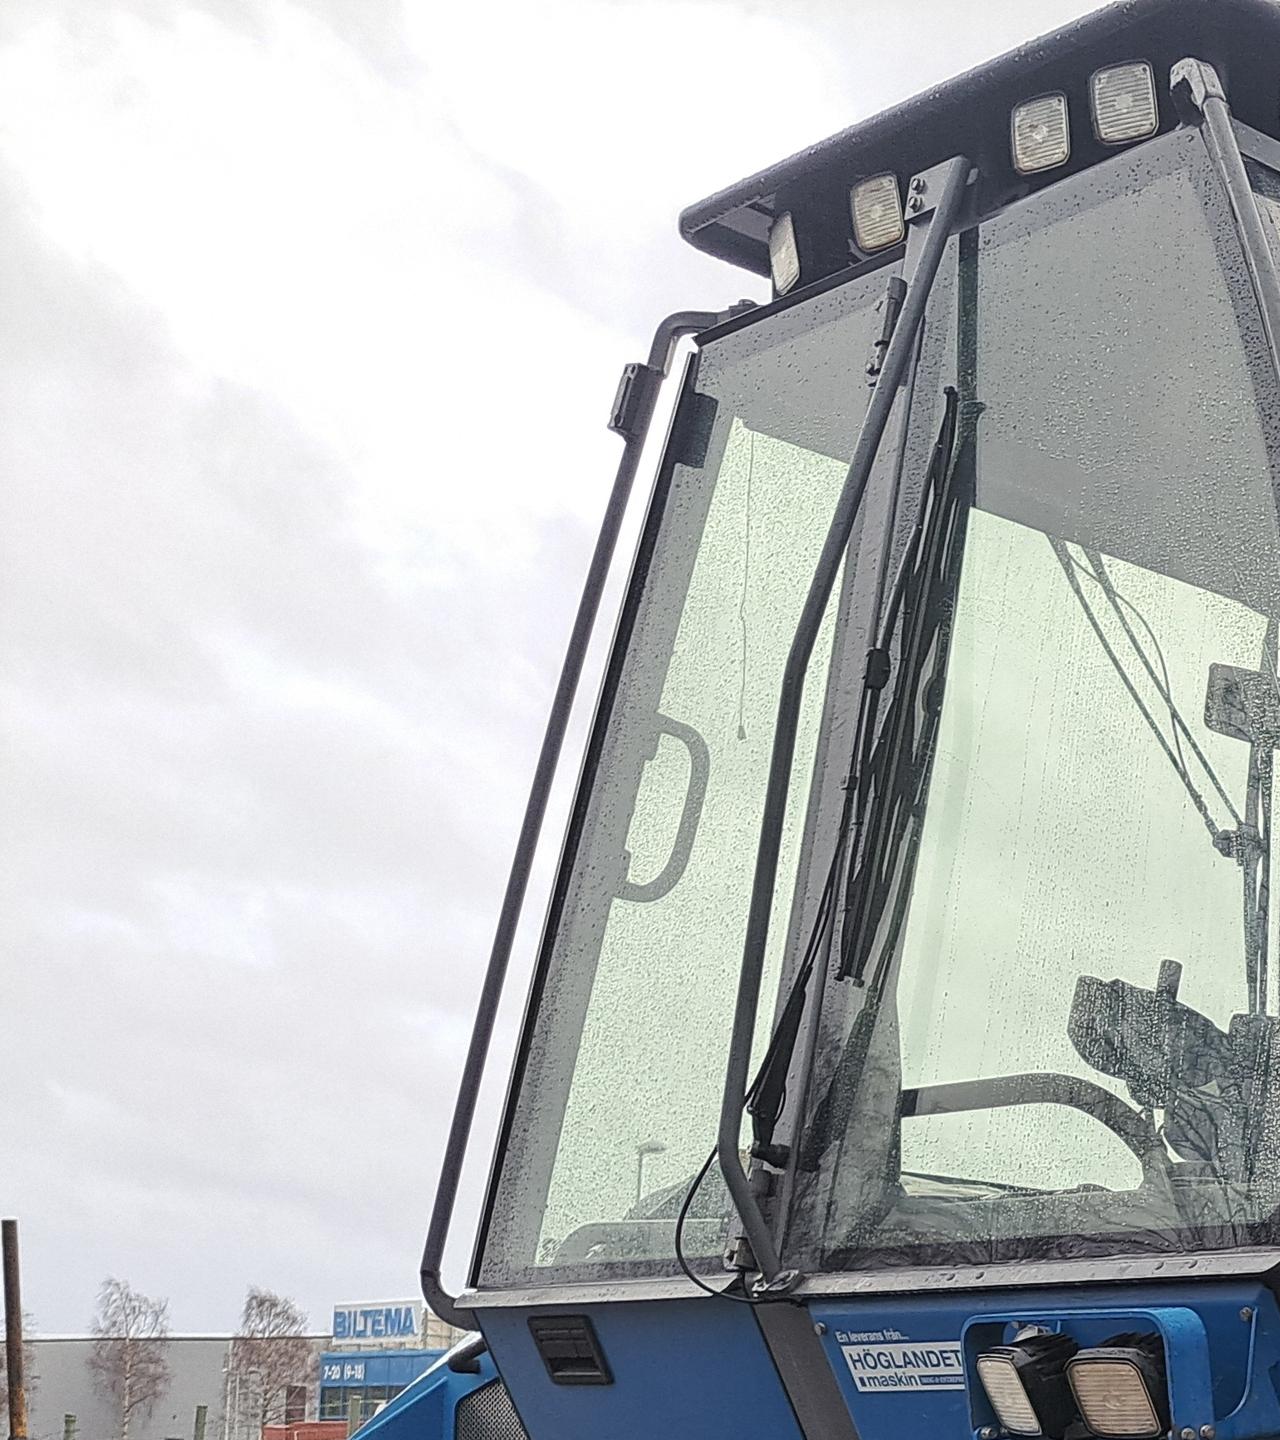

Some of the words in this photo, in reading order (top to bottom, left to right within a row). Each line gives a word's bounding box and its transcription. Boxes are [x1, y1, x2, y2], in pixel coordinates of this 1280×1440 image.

[333, 1306, 418, 1339] BILTEMA
[848, 1349, 961, 1370] HÖGLANDET
[866, 1372, 920, 1387] maskin
